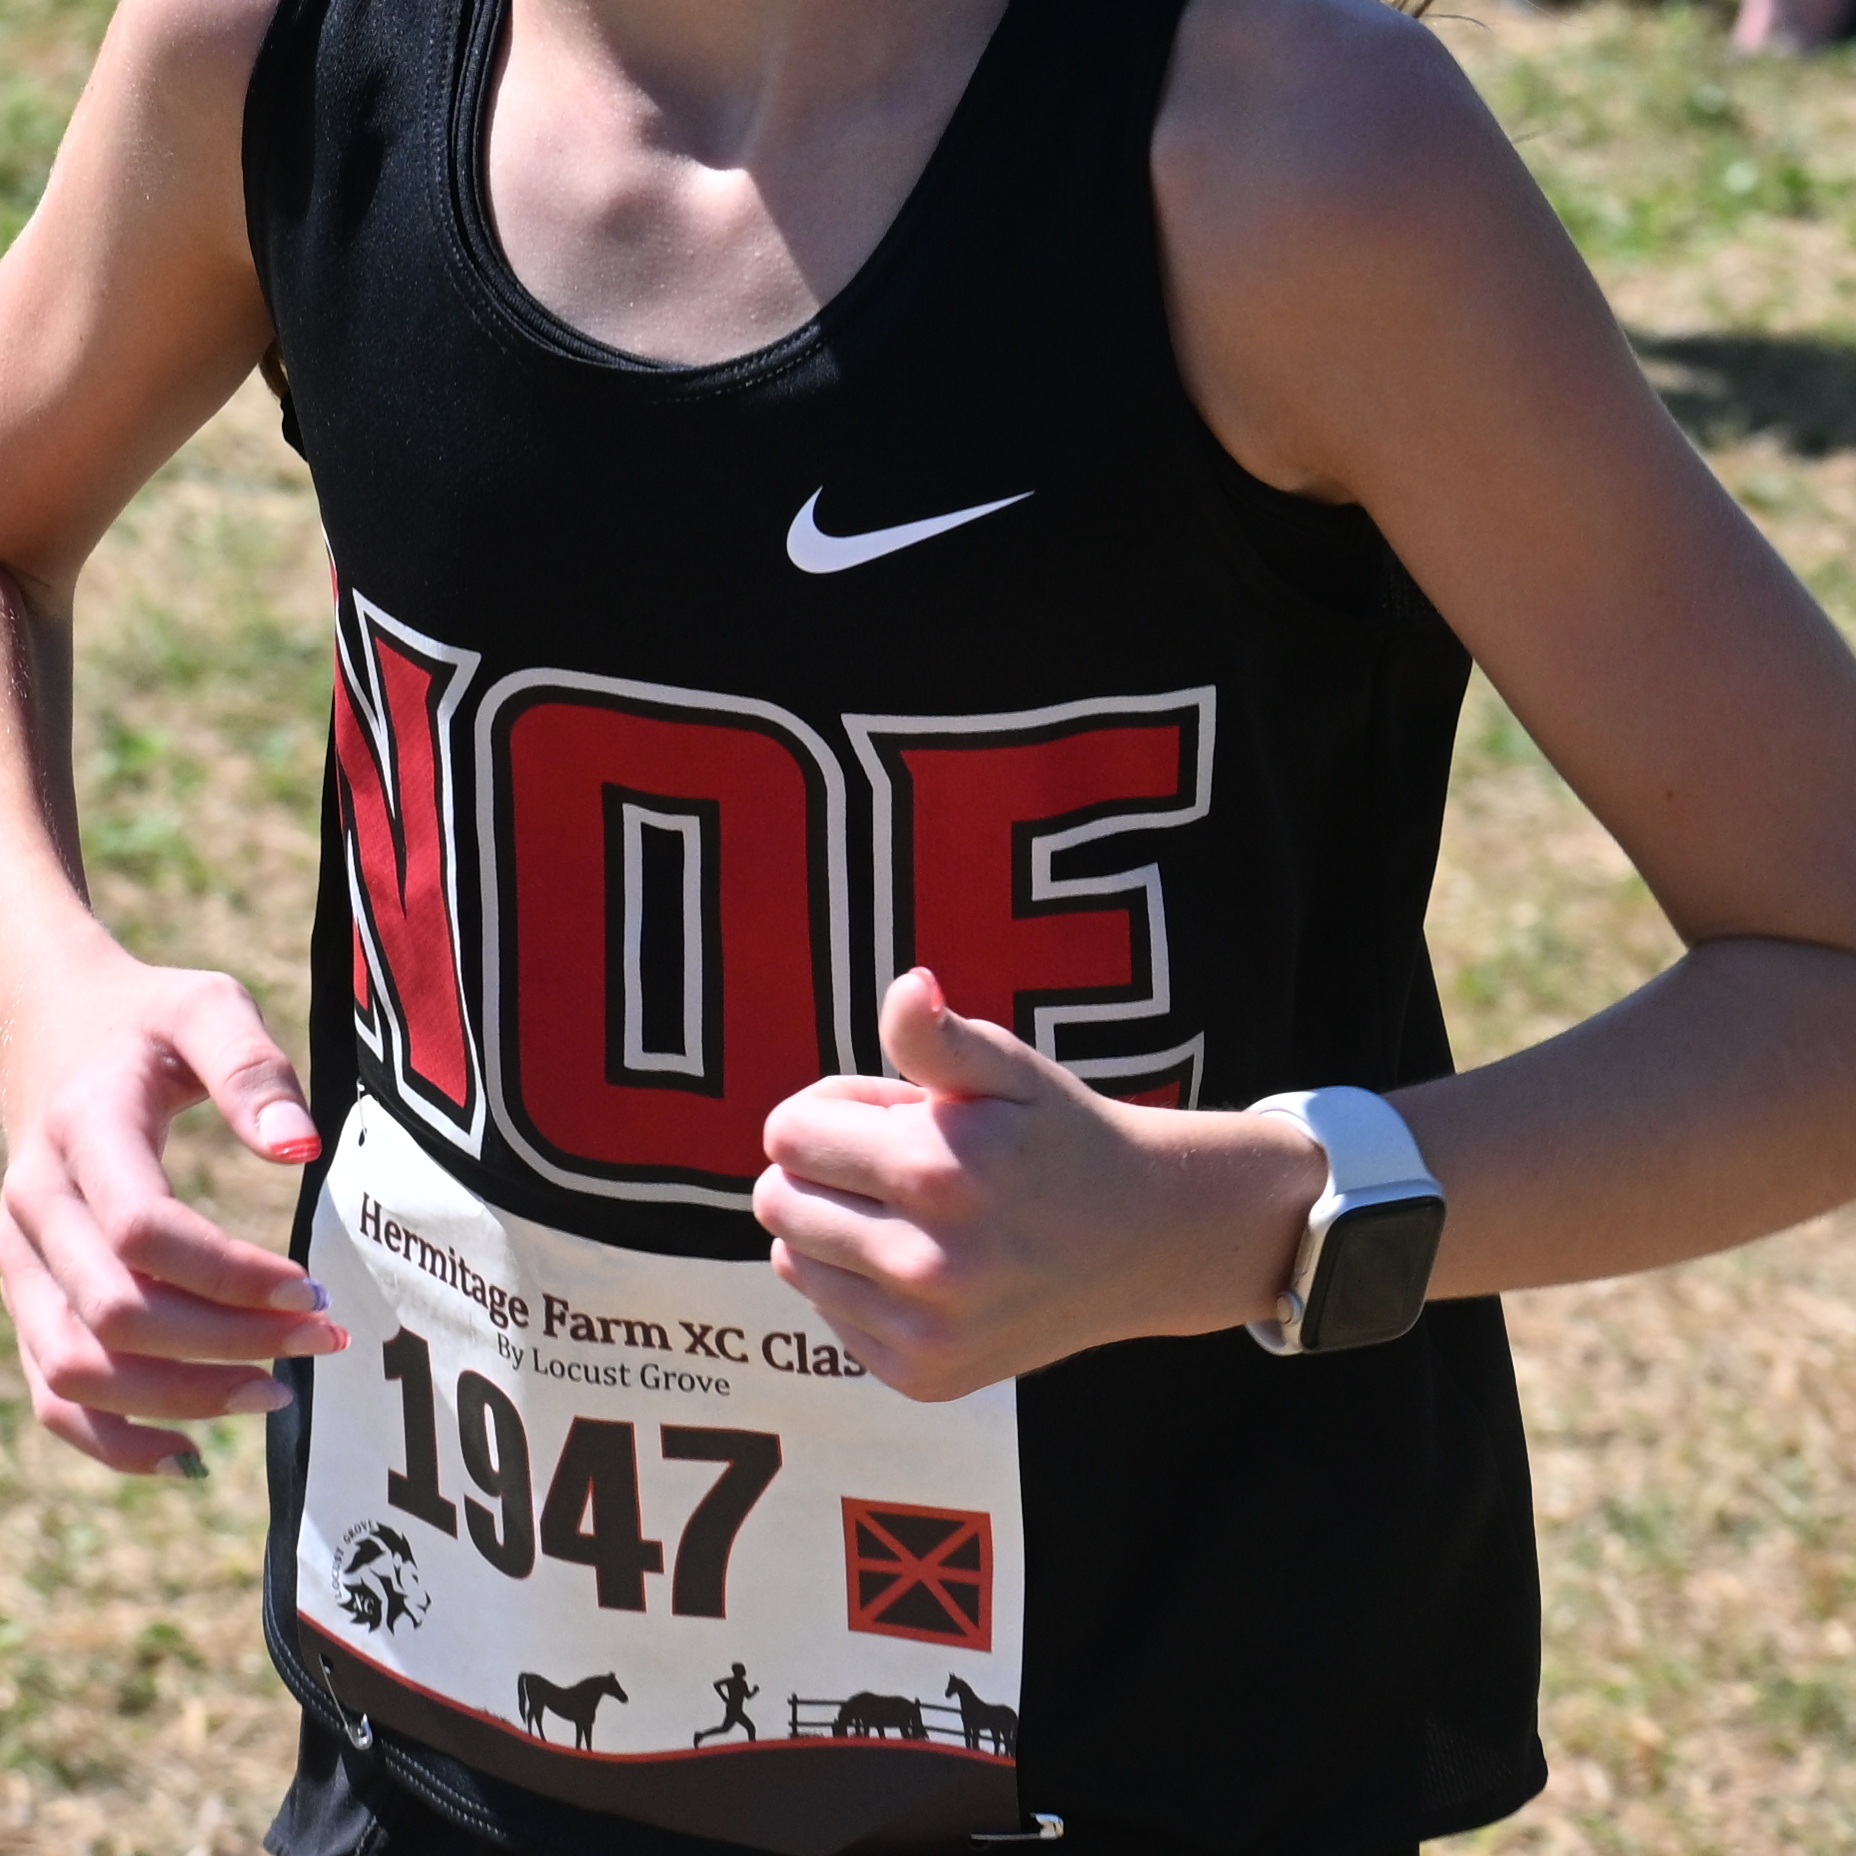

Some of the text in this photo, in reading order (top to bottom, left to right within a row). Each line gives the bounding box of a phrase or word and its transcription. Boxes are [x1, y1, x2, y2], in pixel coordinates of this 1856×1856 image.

[332, 574, 1216, 1210] NOE
[359, 1191, 867, 1378] Hermitage Farm XC Clas
[497, 1332, 731, 1397] By Locust Grove
[343, 1518, 374, 1545] GROVE
[382, 1324, 783, 1620] 1947
[352, 1591, 375, 1616] XC
